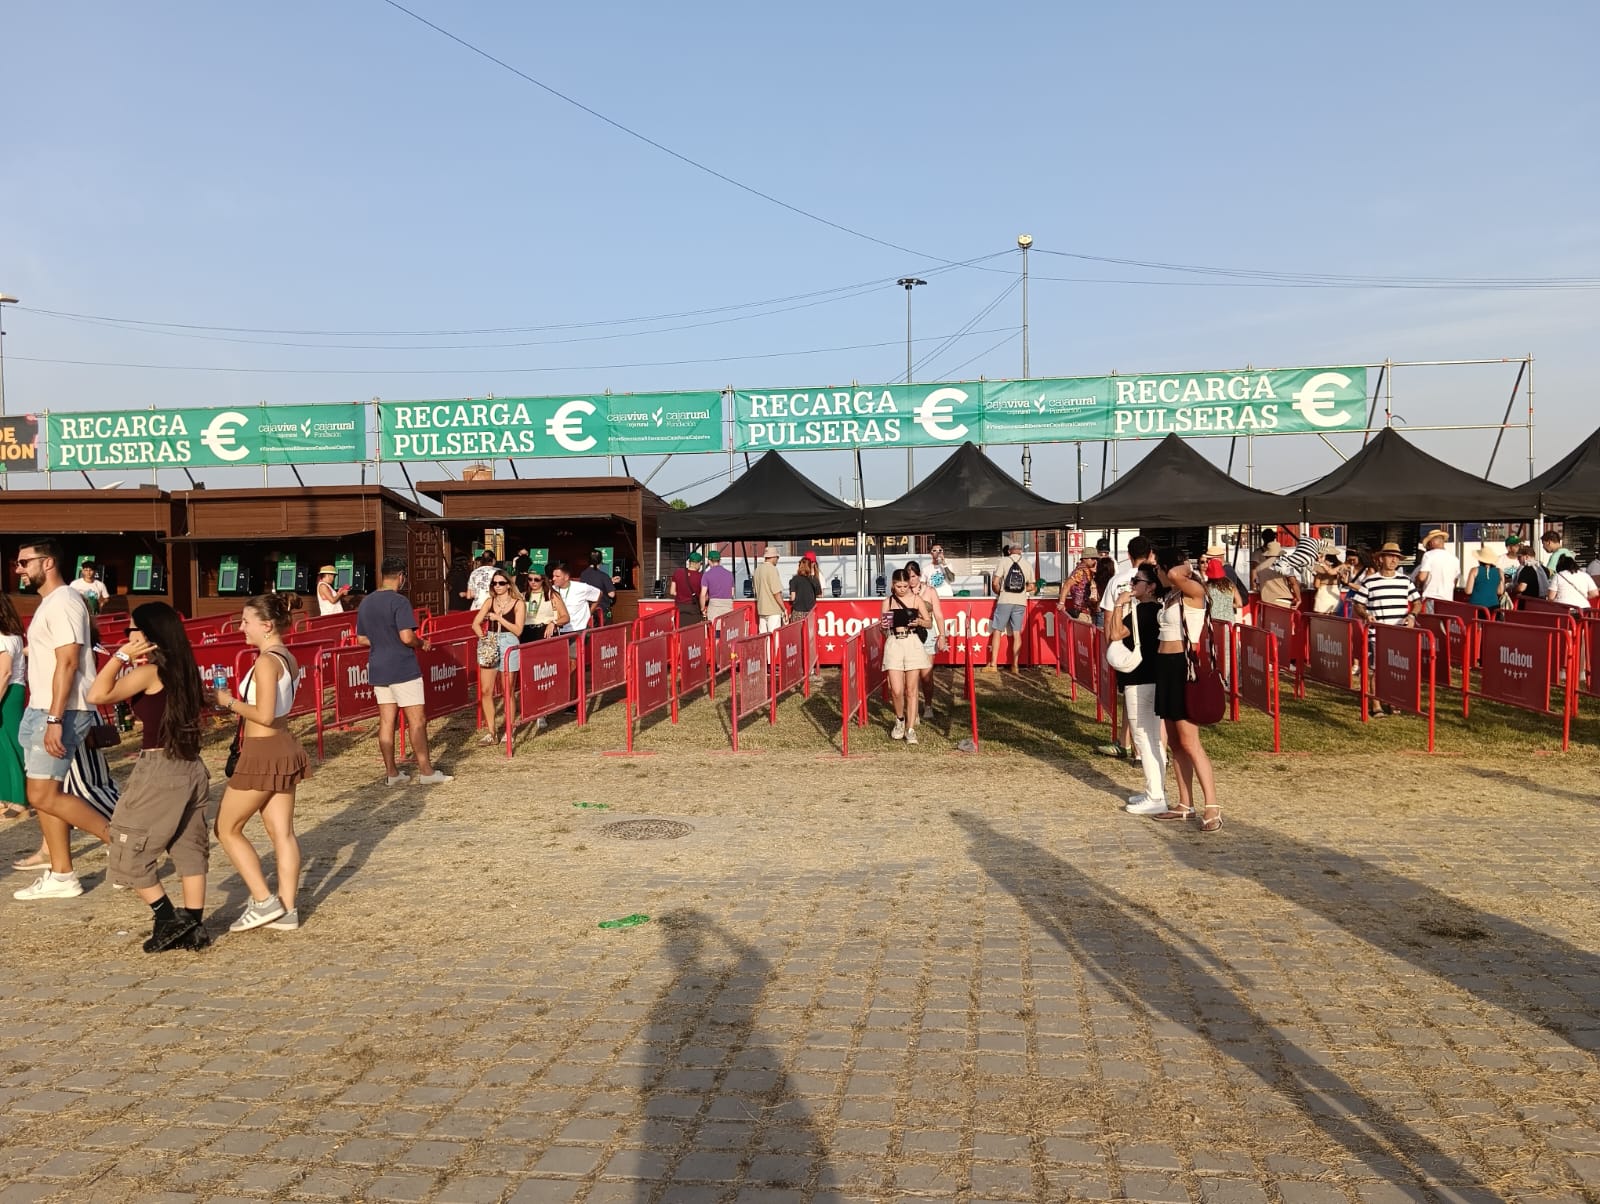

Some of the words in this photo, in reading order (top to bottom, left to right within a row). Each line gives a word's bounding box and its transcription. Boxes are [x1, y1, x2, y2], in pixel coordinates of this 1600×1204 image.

[1116, 375, 1276, 405] RECARGA
[1292, 372, 1352, 427] €
[394, 403, 532, 429] RECARGA
[665, 409, 710, 422] cajarural
[750, 390, 898, 418] RECARGA
[913, 387, 969, 441] €
[60, 414, 188, 439] RECARGA
[258, 422, 297, 434] cajaviva
[313, 421, 355, 433] cajarural
[545, 400, 598, 452] €
[606, 411, 648, 424] cajaviva
[1114, 405, 1278, 434] PULSERAS
[200, 411, 250, 461] €
[393, 430, 535, 456] PULSERAS
[748, 418, 900, 446] PULSERAS
[59, 440, 192, 466] PULSERAS
[811, 536, 875, 546] ROMEA
[1499, 646, 1533, 668] Mahou
[431, 663, 457, 683] Mahou
